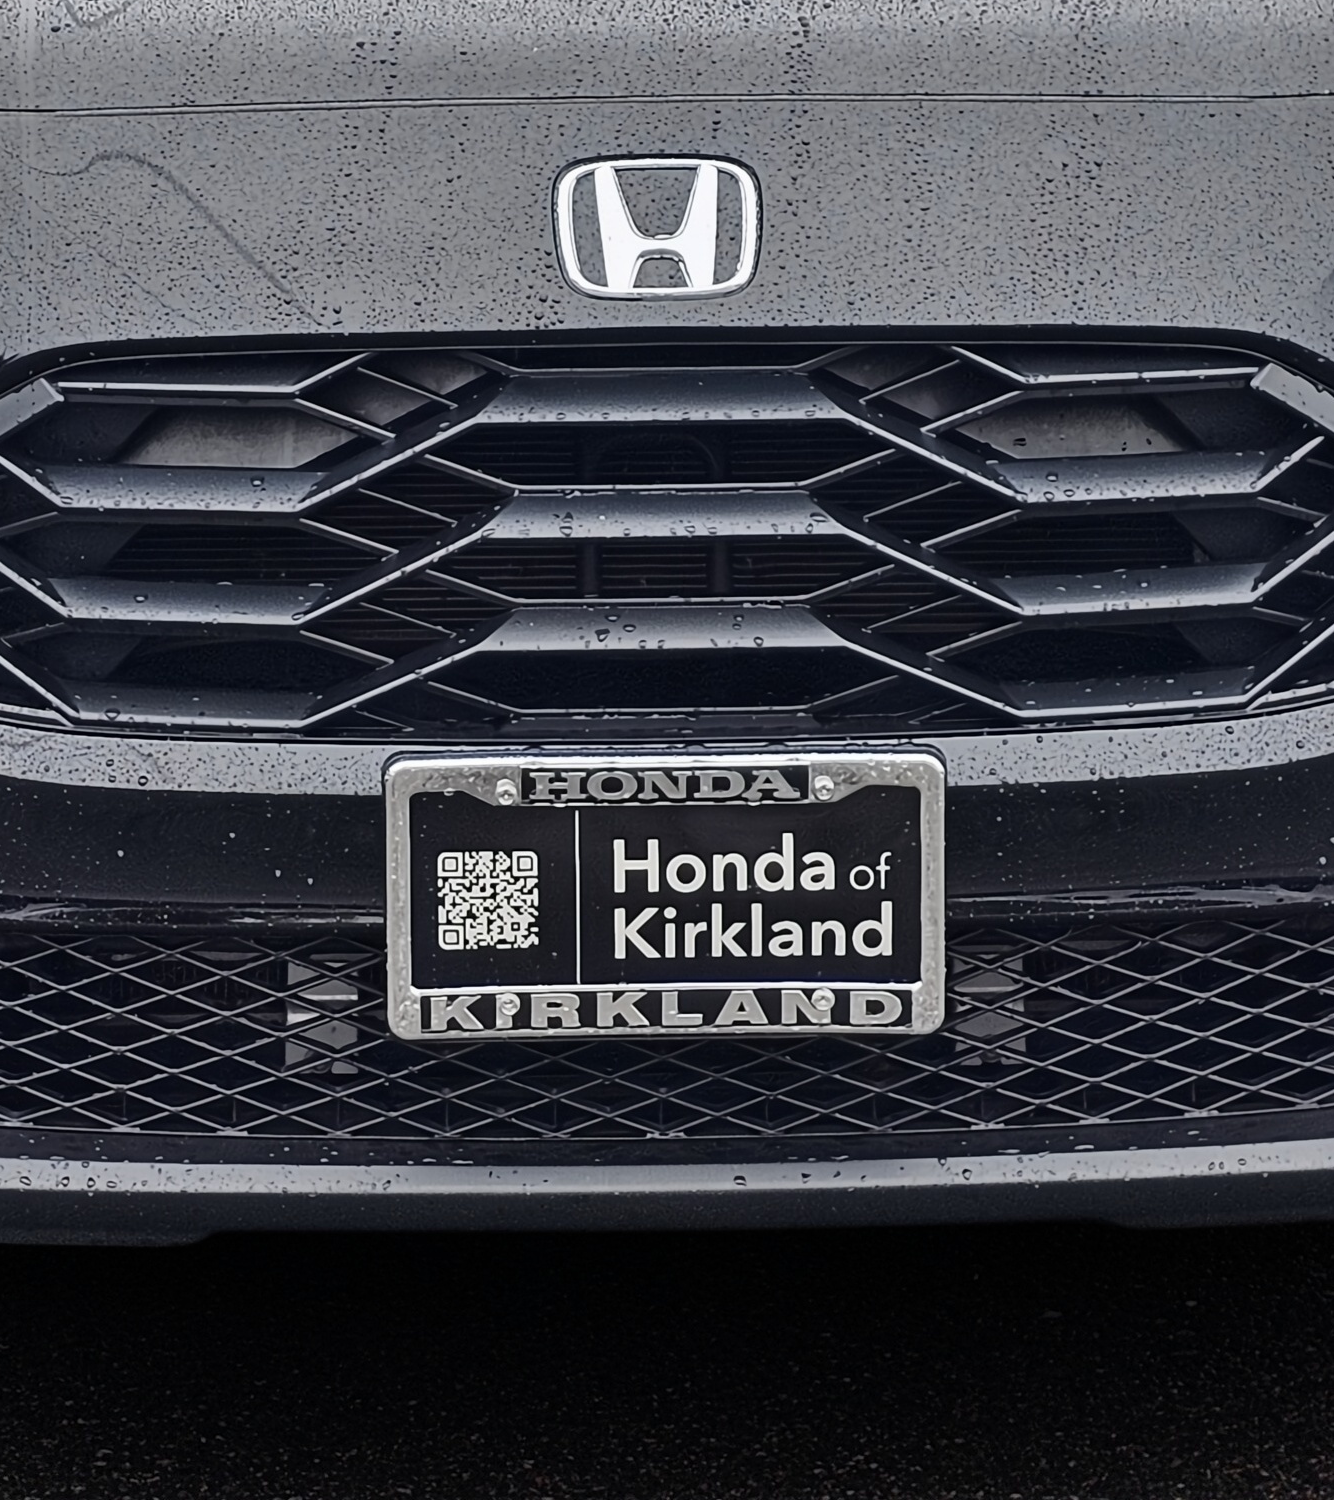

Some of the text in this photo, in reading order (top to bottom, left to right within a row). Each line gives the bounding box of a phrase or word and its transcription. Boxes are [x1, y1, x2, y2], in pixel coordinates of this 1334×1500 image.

[529, 769, 801, 800] HONDA
[612, 833, 892, 893] Honda of
[612, 901, 893, 959] Kirkland
[429, 989, 903, 1031] KIRKLAND
